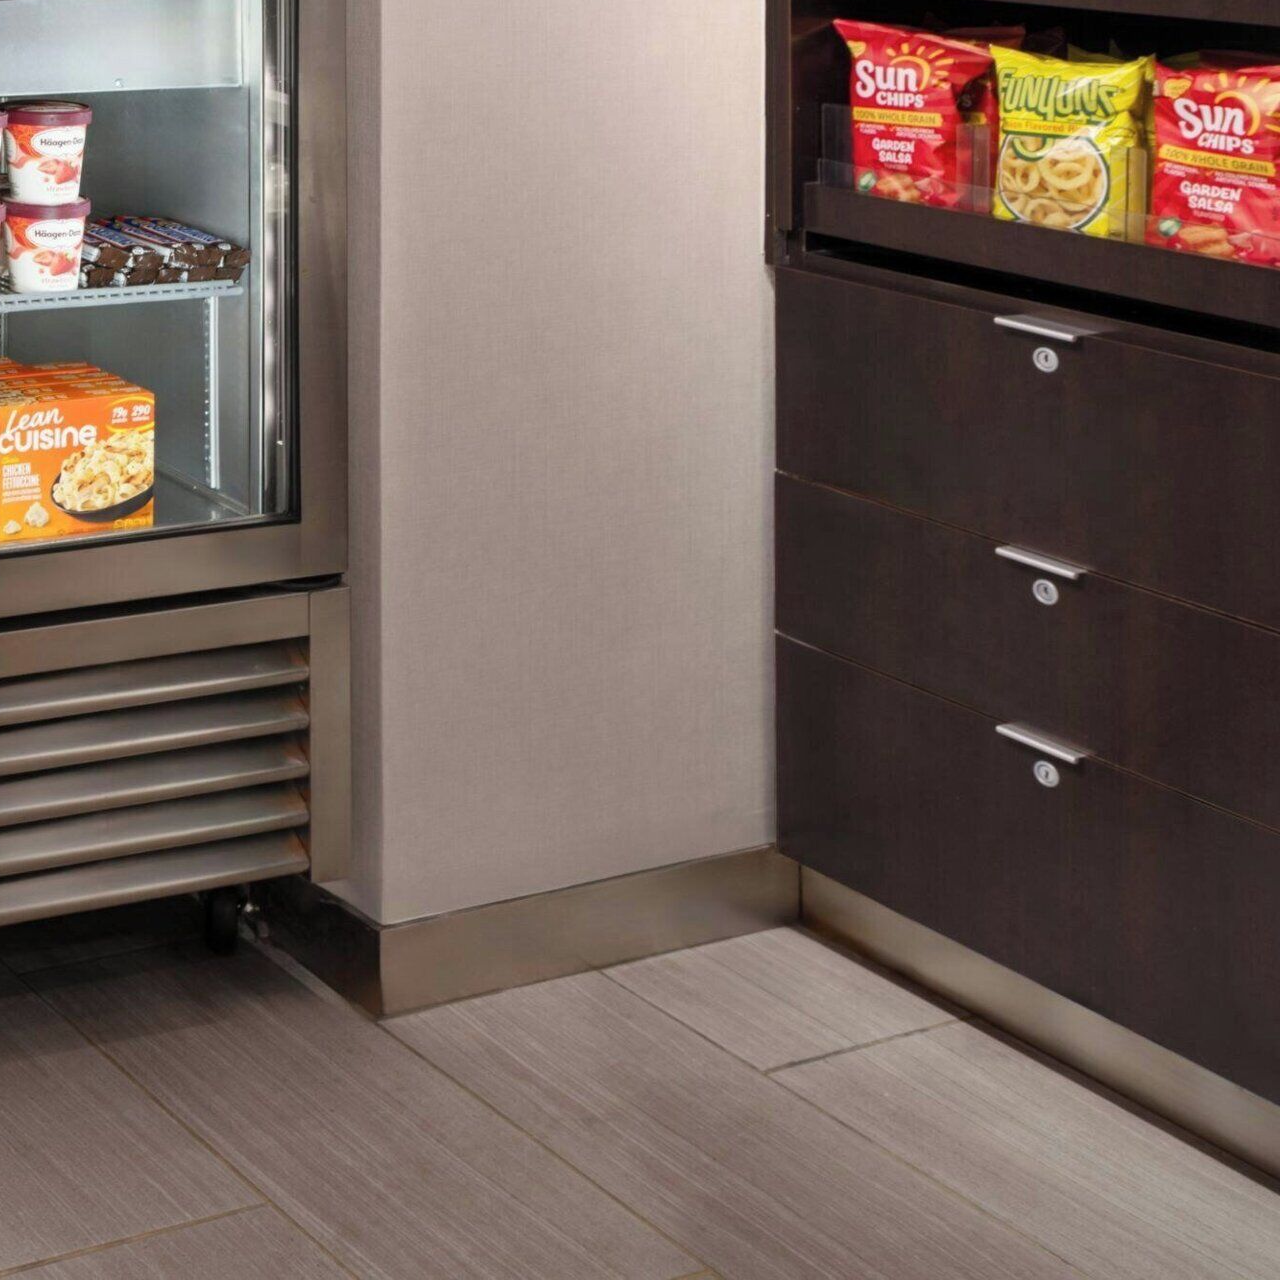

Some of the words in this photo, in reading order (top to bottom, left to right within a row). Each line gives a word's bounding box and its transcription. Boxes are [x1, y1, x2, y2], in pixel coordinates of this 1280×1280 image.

[856, 60, 918, 98] Sun
[876, 90, 924, 108] CHIPS
[998, 67, 1122, 124] FUNYUNS
[877, 111, 906, 122] WHOLE
[907, 114, 936, 125] GRAIN
[1174, 98, 1246, 139] Sun
[40, 137, 84, 147] Häagen-Daz
[872, 137, 915, 153] GARDEN
[1197, 132, 1255, 154] CHIPS
[879, 150, 913, 164] SALSA
[1190, 153, 1228, 169] WHOLE
[1231, 160, 1269, 174] GRAIN
[1180, 180, 1242, 202] GARDEN
[1188, 195, 1234, 214] SALSA
[35, 229, 81, 239] Häagen-Daz
[131, 404, 151, 417] 290
[6, 407, 64, 438] Lean
